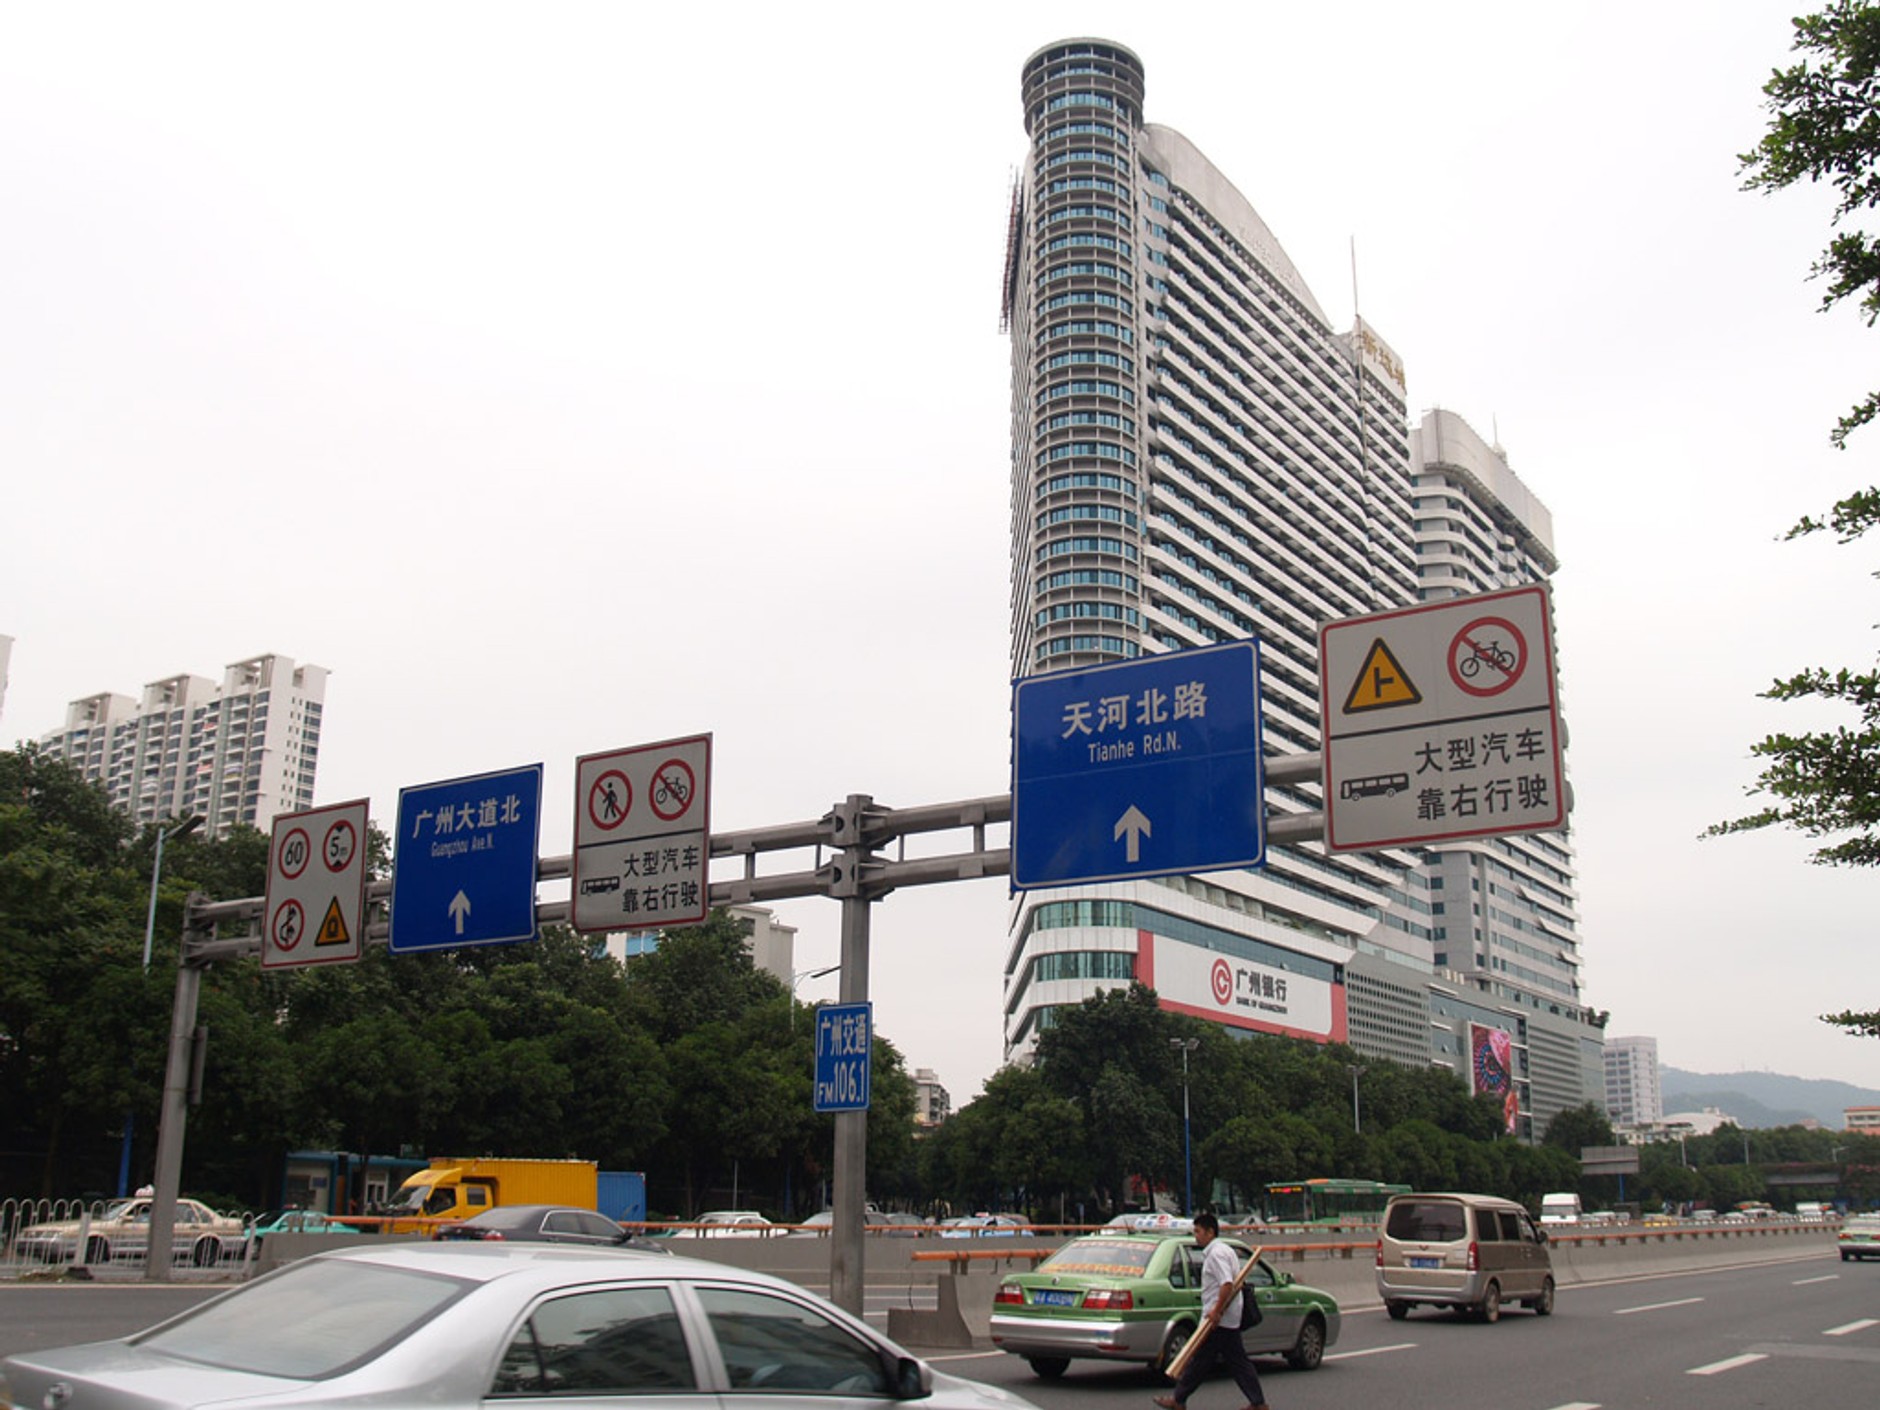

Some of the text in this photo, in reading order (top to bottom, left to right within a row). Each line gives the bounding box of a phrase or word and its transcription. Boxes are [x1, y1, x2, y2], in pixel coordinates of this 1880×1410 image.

[1061, 680, 1208, 740] 天河北路
[1087, 731, 1182, 763] Tianhe Rd.N.
[1414, 727, 1546, 775] 大型汽车
[412, 793, 521, 839] 广州大道北
[1417, 773, 1549, 821] 靠右行驶
[284, 840, 304, 866] 60
[623, 845, 699, 878] 大型汽车
[622, 880, 699, 914] 靠右行驶
[1235, 967, 1287, 1003] 广州银行
[819, 1013, 867, 1056] 广州交通
